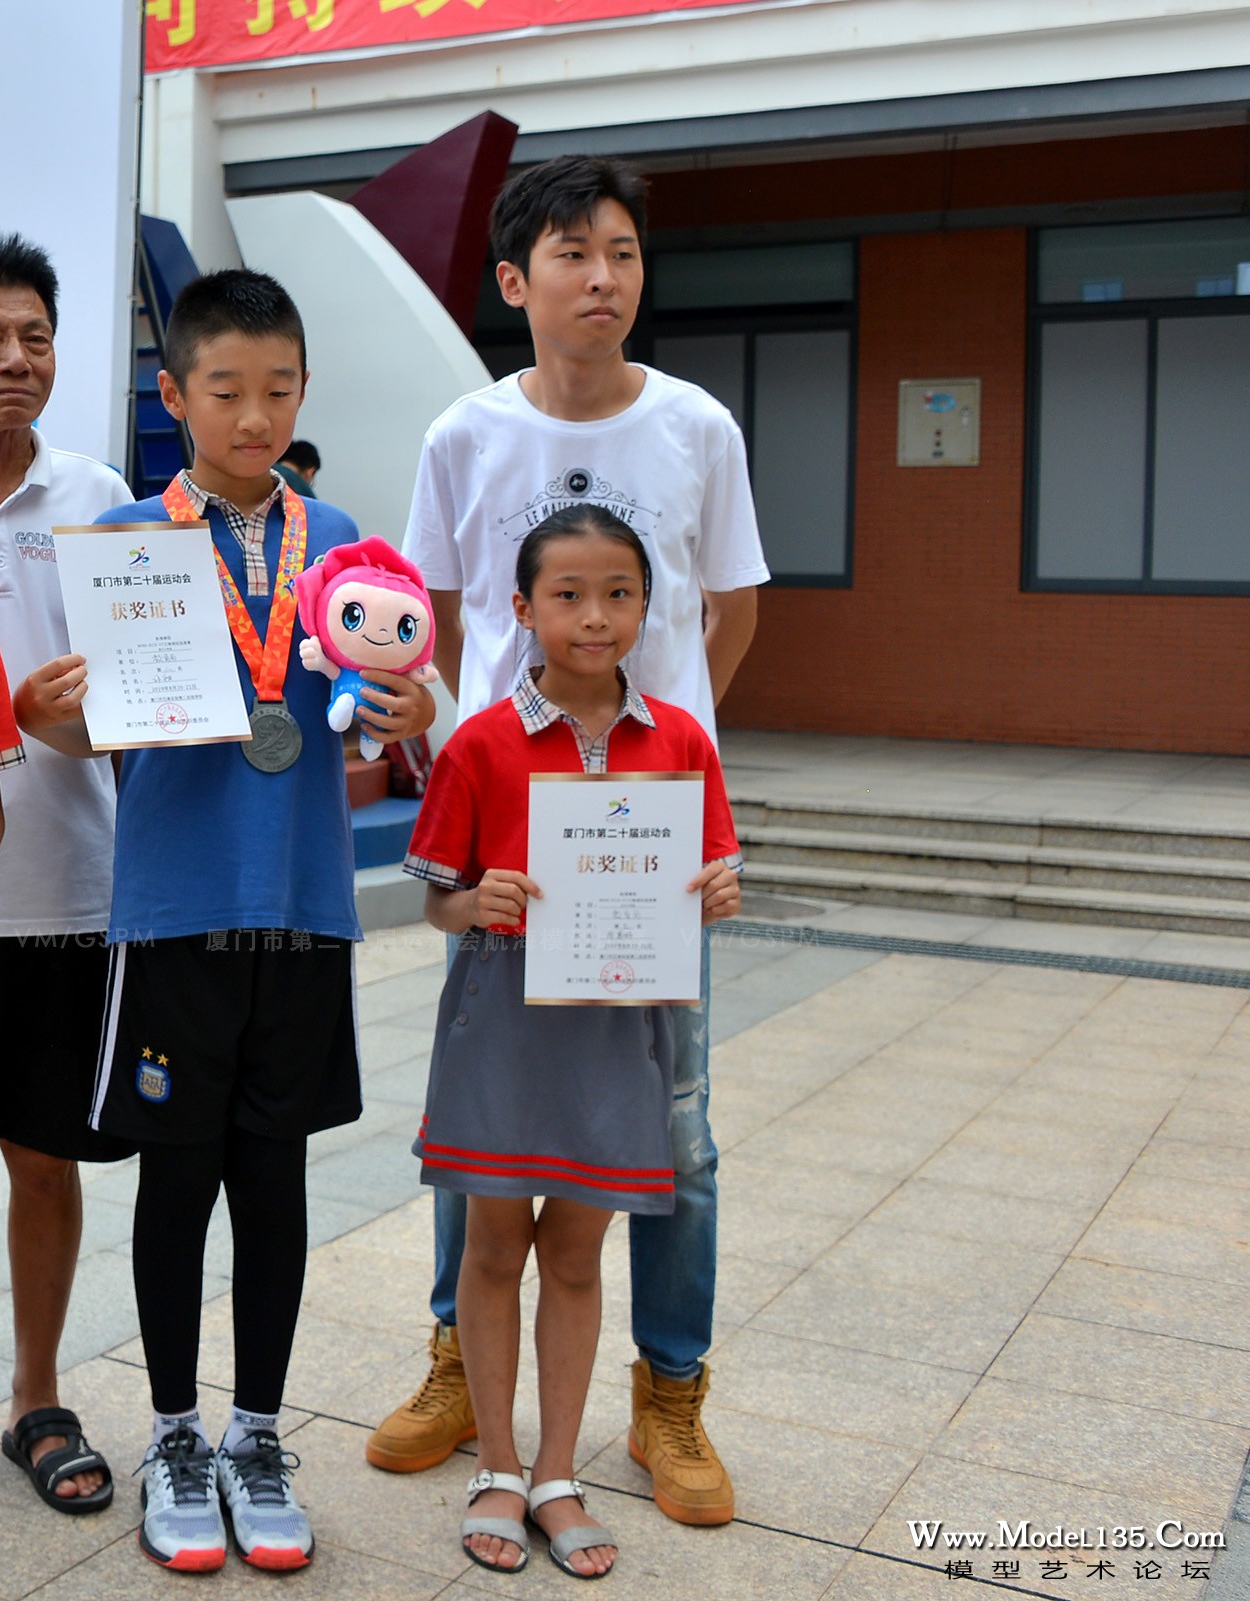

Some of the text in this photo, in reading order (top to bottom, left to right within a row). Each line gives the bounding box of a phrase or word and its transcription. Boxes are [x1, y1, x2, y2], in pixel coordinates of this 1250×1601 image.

[524, 510, 541, 527] LE
[92, 574, 192, 588] 厦门市第二十届运动会
[110, 599, 186, 621] 获奖证书
[562, 827, 672, 839] 厦门市第二十届运动会
[576, 855, 659, 874] 获奖证书
